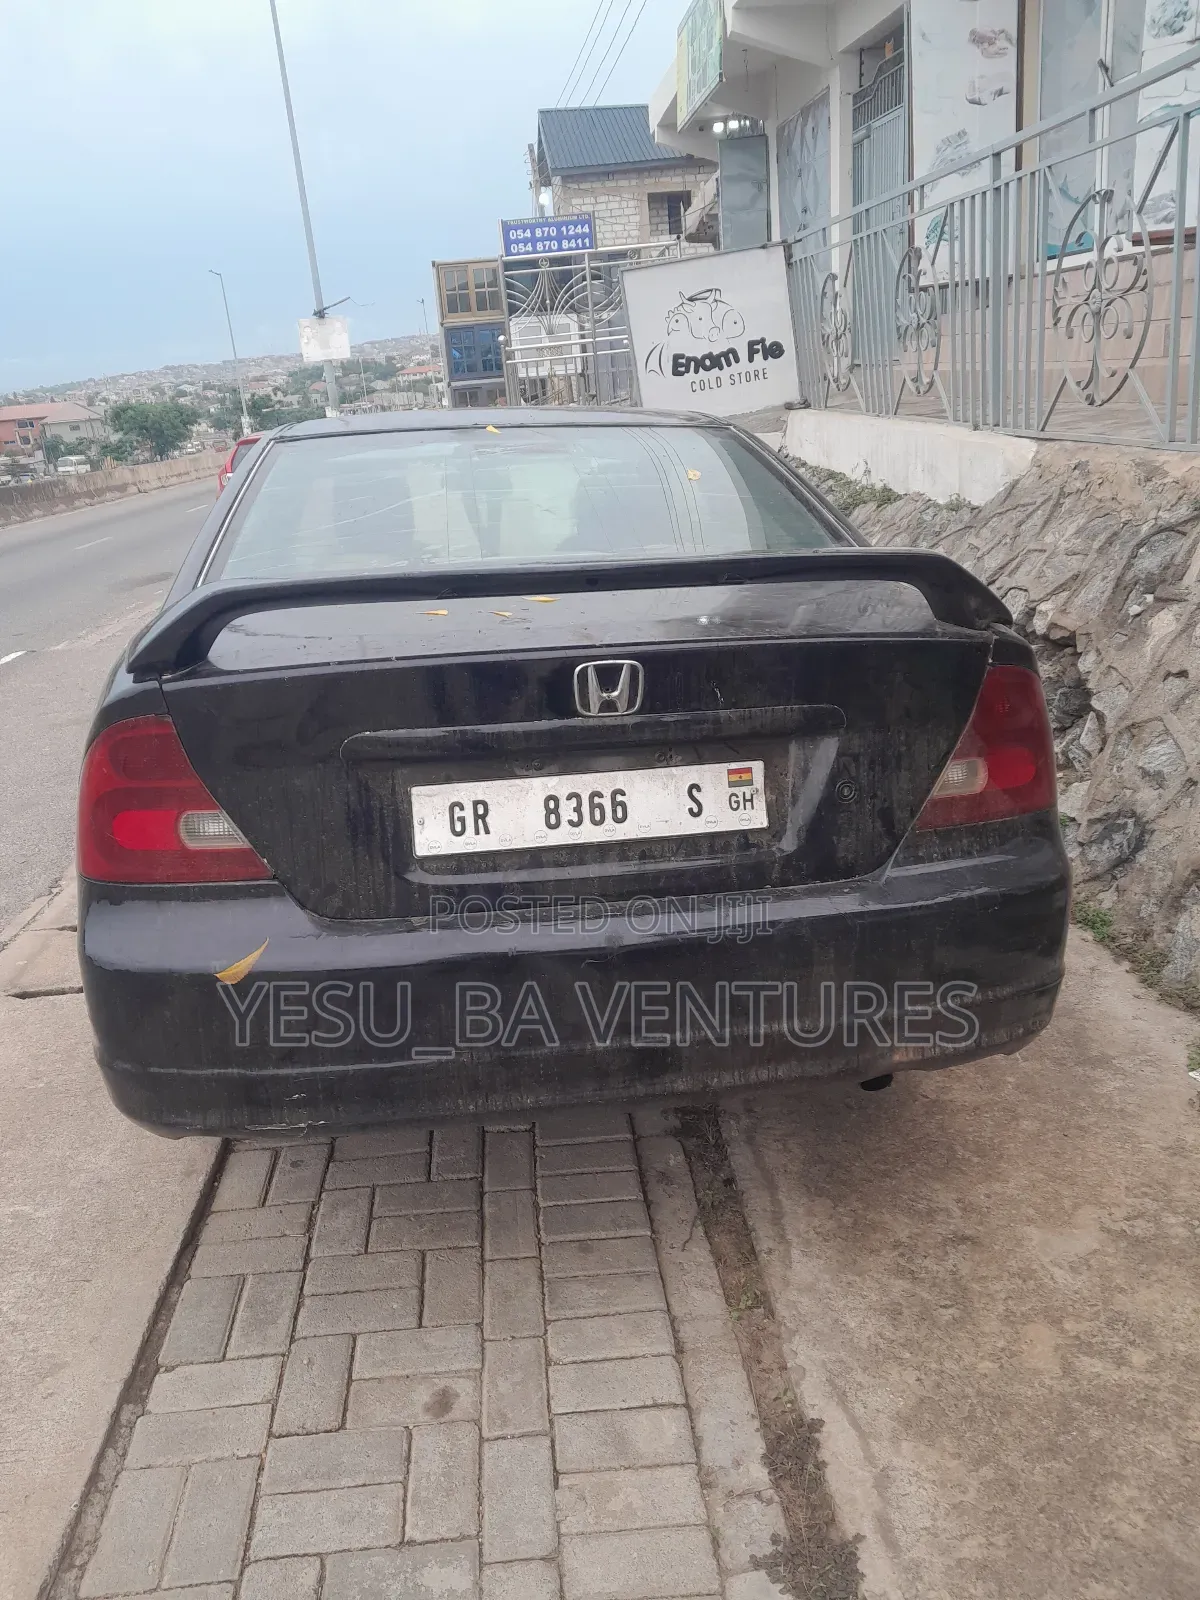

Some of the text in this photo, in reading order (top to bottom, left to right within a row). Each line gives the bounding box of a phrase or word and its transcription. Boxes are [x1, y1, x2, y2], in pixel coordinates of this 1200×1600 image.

[509, 223, 590, 240] 054 870 1244
[510, 237, 590, 253] 054 870 8411
[672, 336, 785, 377] Enam Fie
[690, 367, 769, 393] COLD STORE
[449, 783, 703, 837] GR 8366 S
[728, 792, 755, 812] GH
